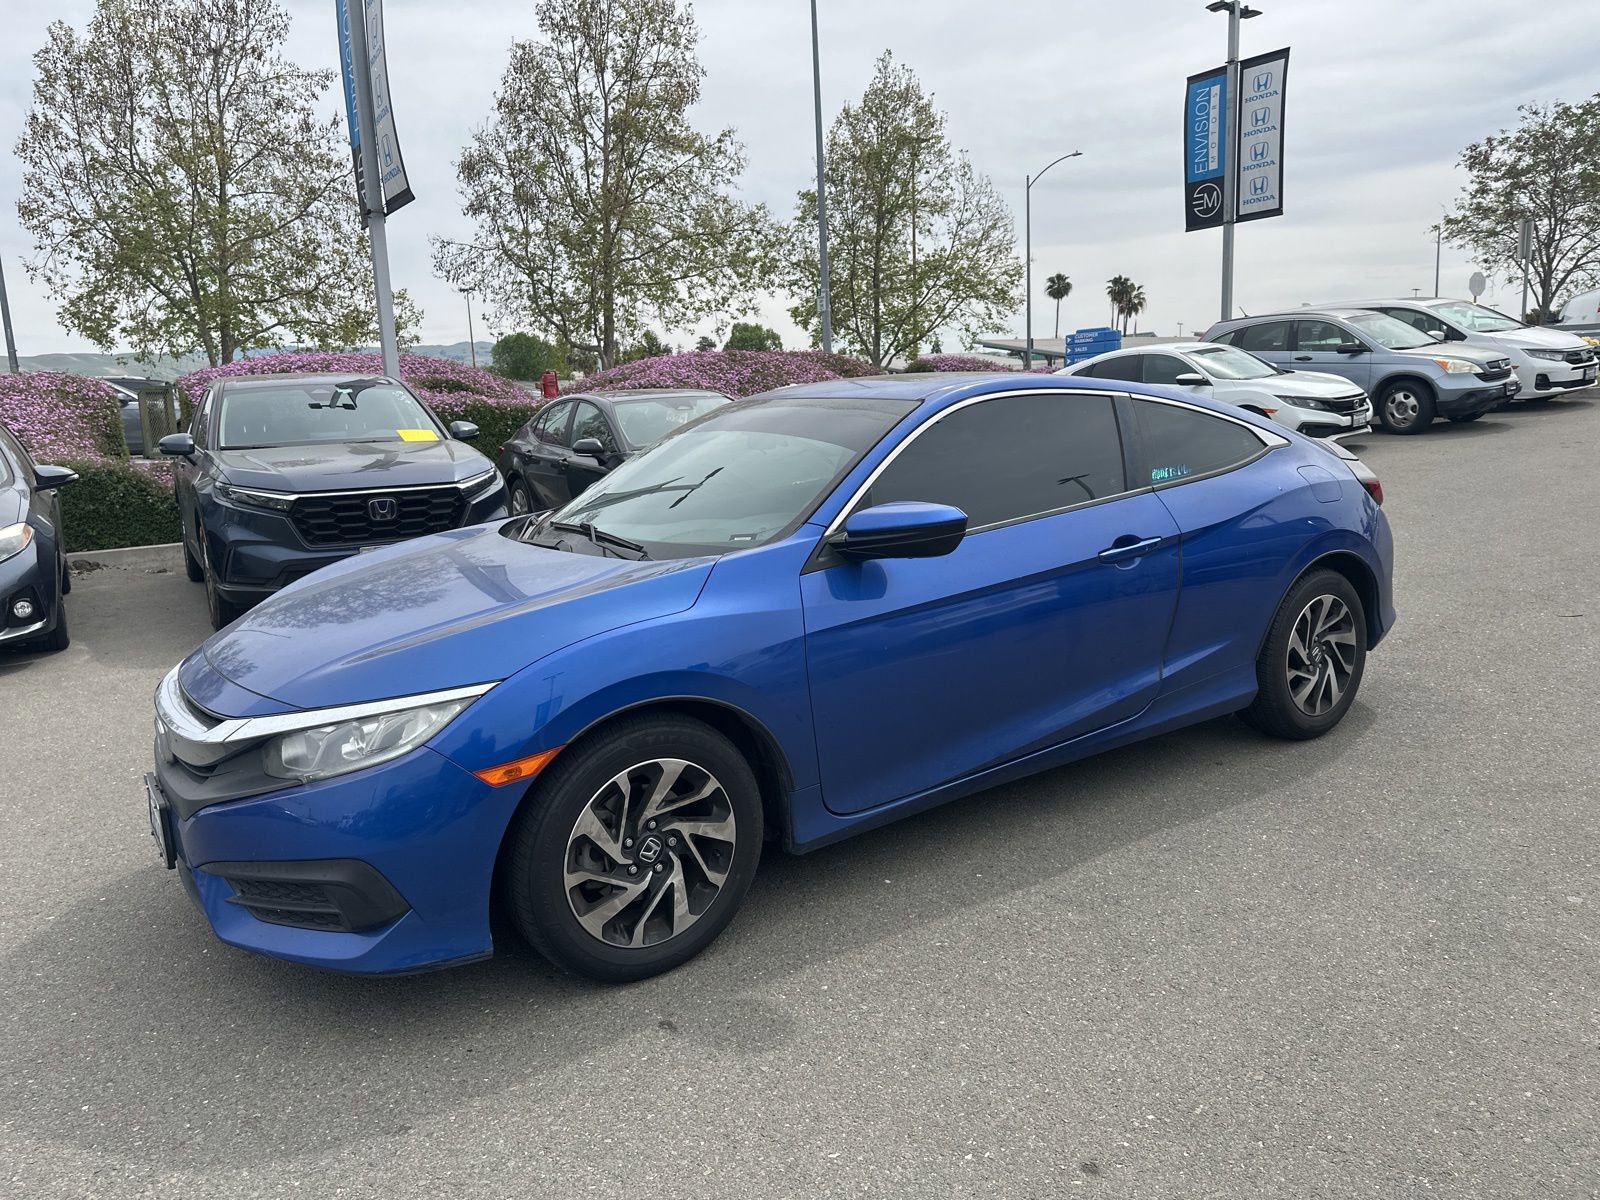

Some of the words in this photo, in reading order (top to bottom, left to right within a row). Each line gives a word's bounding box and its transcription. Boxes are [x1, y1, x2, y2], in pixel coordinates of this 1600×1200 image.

[1244, 90, 1279, 103] HONDA
[1194, 87, 1209, 174] ENVISION
[1210, 92, 1218, 164] MOTORS
[1243, 125, 1277, 138] HONDA
[1242, 160, 1276, 172] HONDA
[1242, 194, 1276, 206] HONDA
